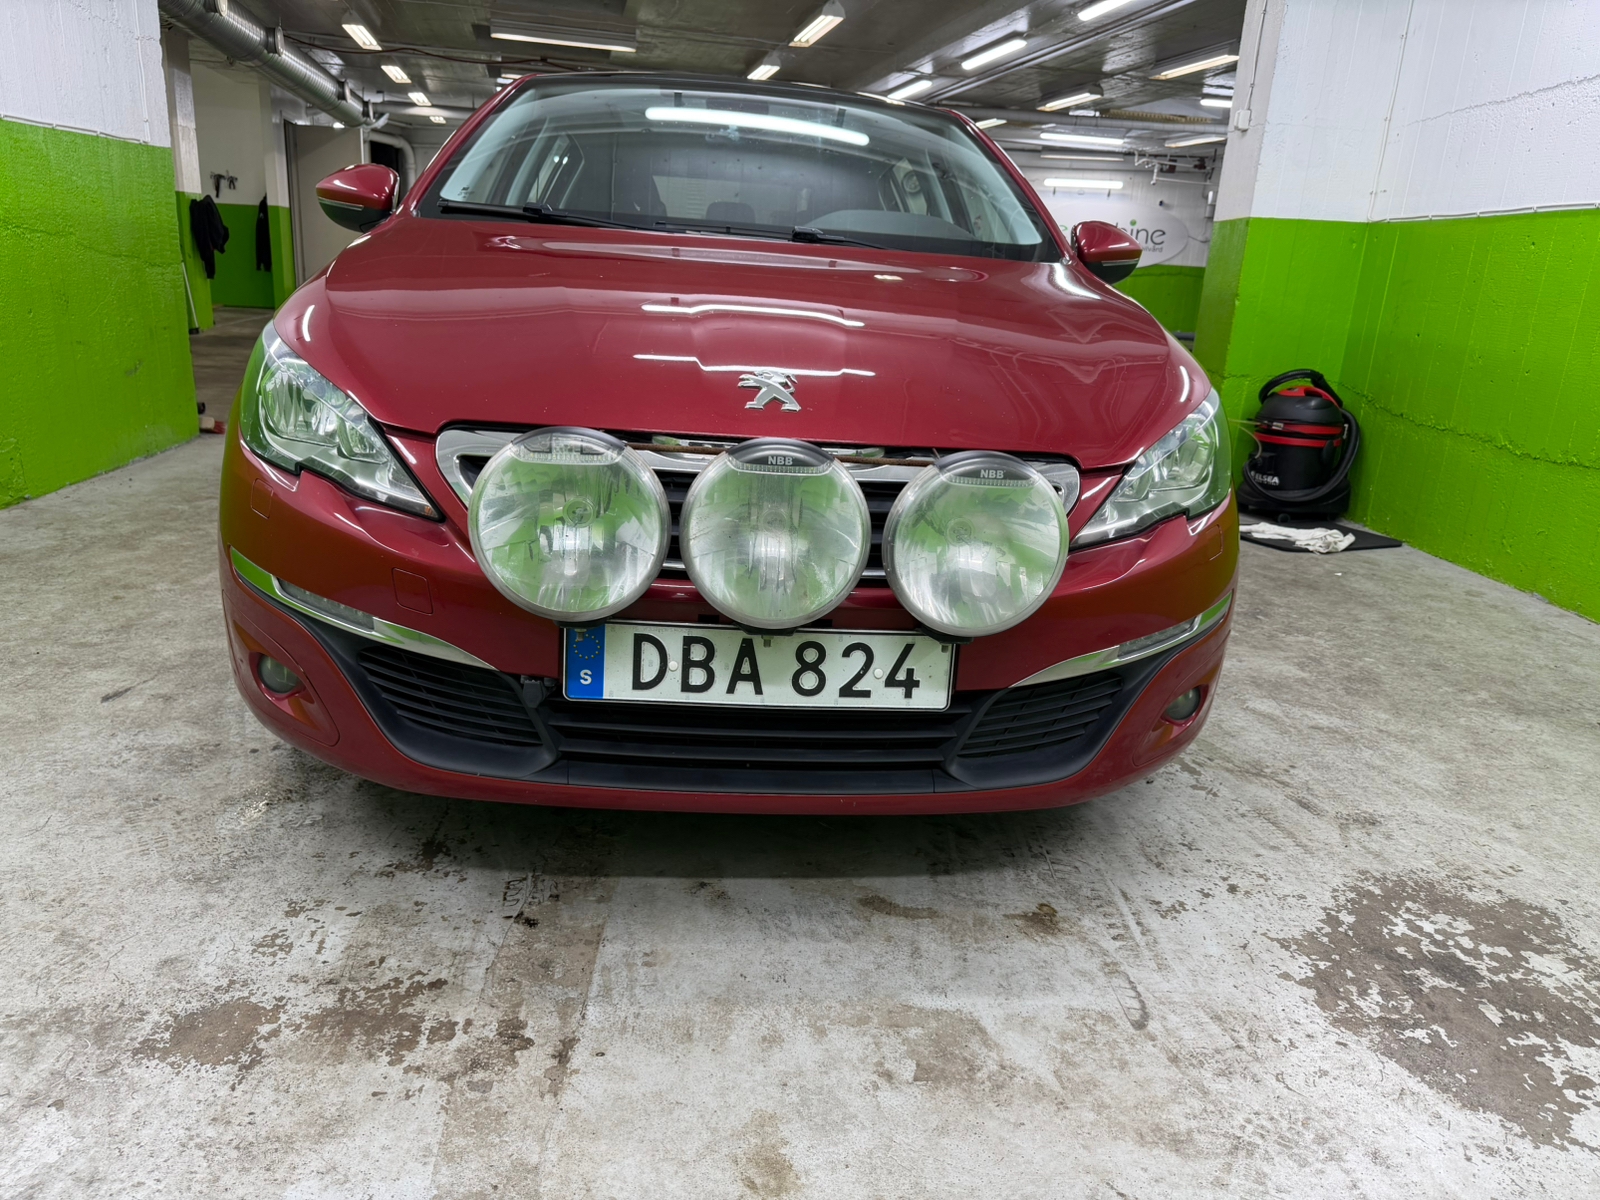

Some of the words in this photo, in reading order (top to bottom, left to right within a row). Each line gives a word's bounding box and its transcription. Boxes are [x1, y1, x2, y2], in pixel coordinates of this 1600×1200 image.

[767, 455, 793, 466] NBB
[980, 469, 1004, 479] NBB
[1255, 472, 1280, 484] ELSEA
[632, 633, 763, 695] DBA
[791, 640, 920, 699] 824
[580, 669, 592, 685] S
